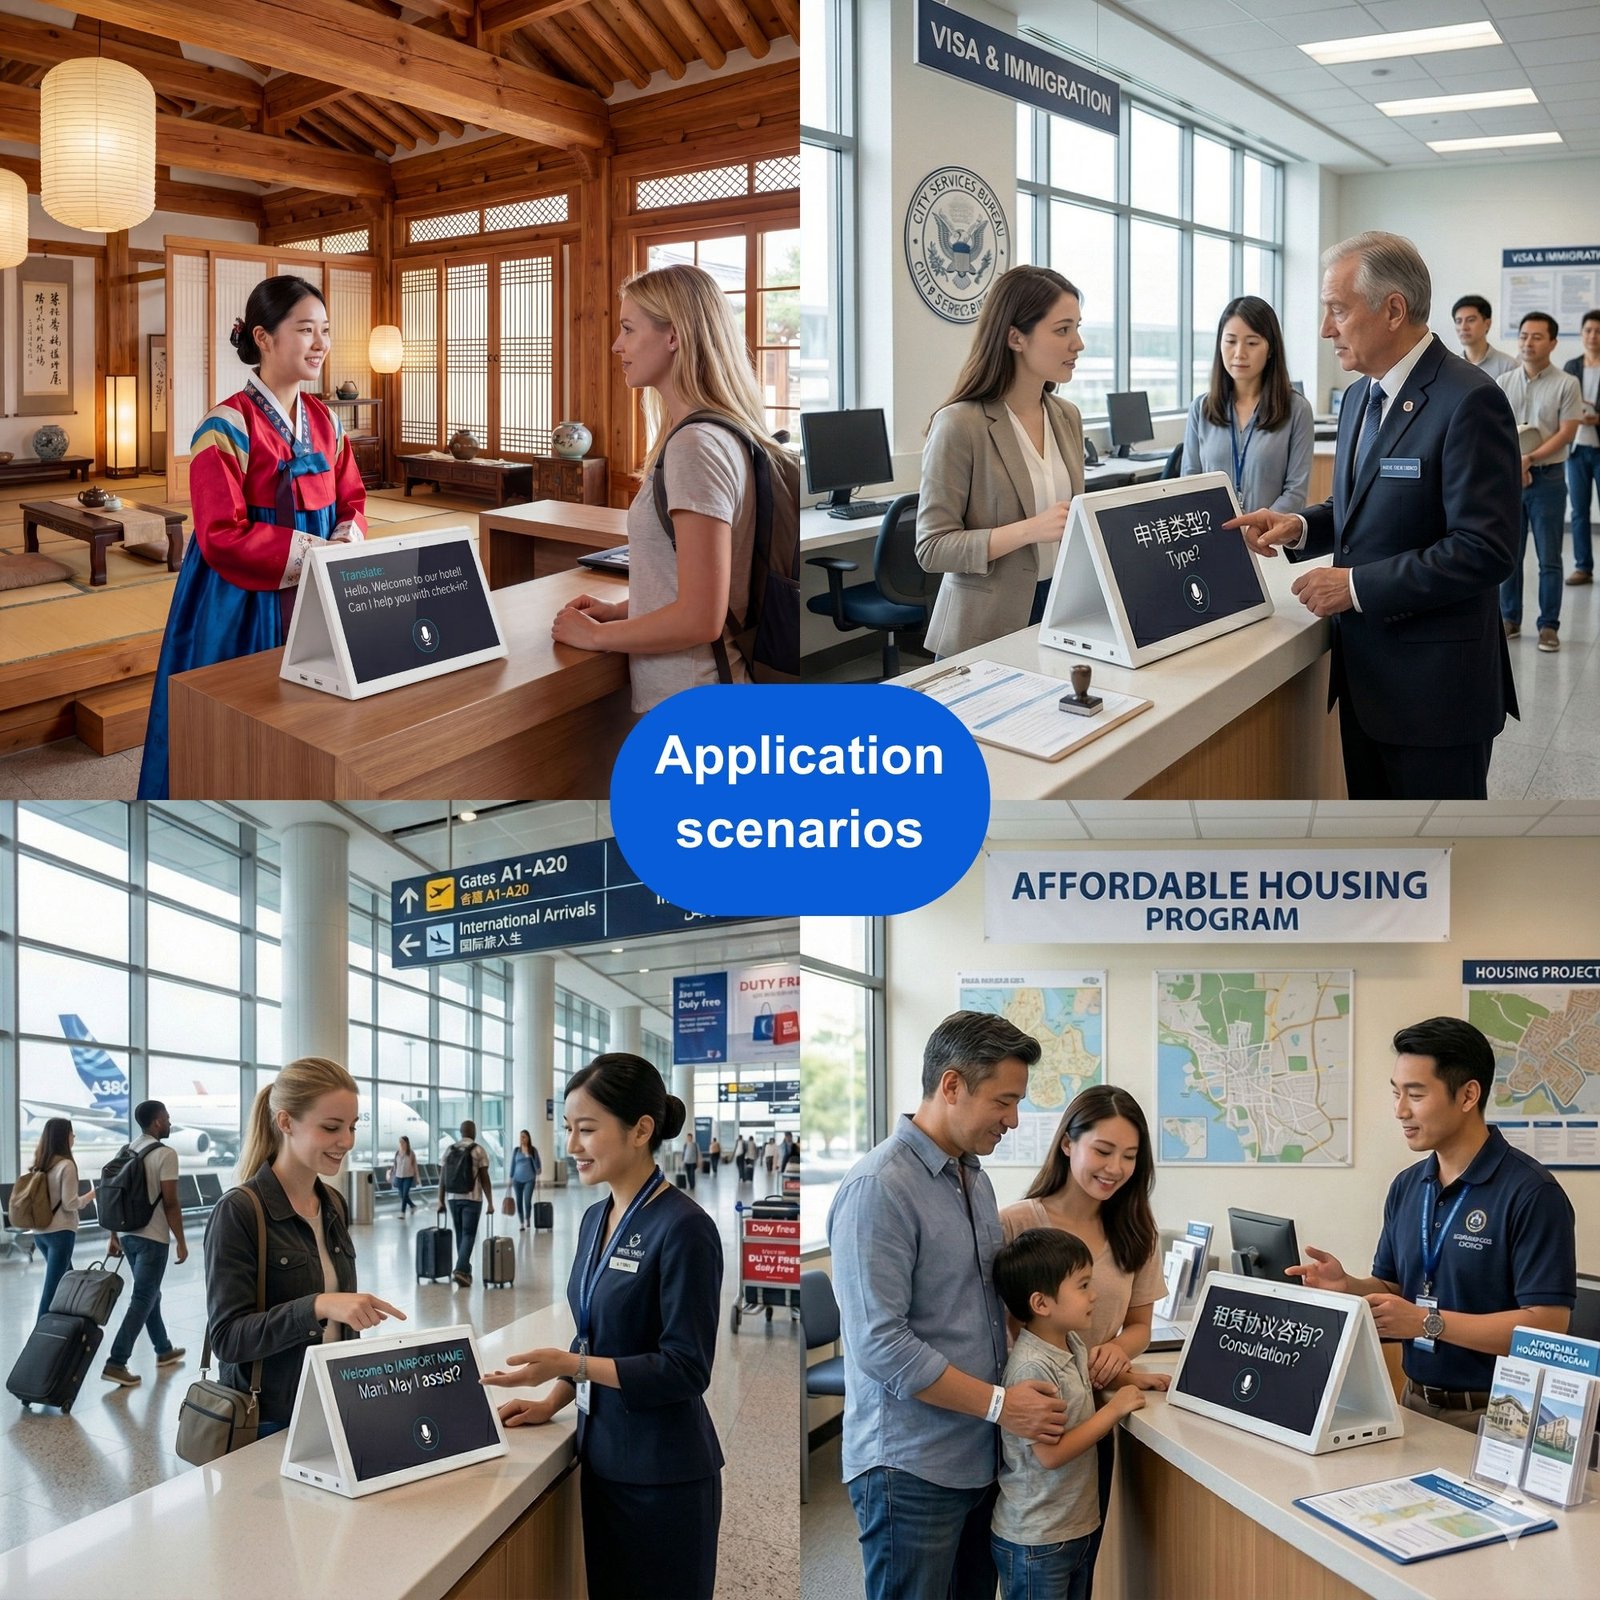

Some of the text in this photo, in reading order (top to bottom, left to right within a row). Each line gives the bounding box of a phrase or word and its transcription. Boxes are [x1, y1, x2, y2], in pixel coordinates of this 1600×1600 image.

[930, 20, 1112, 116] VISA & IMMIGRATION
[913, 174, 1006, 238] CITY SERVICES BUREAU
[1511, 252, 1535, 263] VISA
[1133, 510, 1212, 549] 申请类型?
[1165, 544, 1201, 570] Type?
[340, 566, 385, 582] Translate:
[344, 566, 463, 598] Hello, Welcome to our hotel!
[348, 580, 469, 613] Can I help you with check-in?
[459, 855, 568, 890] Gates A1-A20
[1012, 870, 1428, 900] AFFORDABLE HOUSING
[485, 883, 529, 902] A1-A20
[459, 901, 596, 936] International Arrivals
[1146, 906, 1299, 932] PROGRAM
[740, 978, 775, 992] DUTY
[1475, 966, 1539, 979] HOUSING
[92, 1080, 129, 1096] A380
[748, 1254, 775, 1263] DUTY
[1212, 1305, 1324, 1348] 租赁协议咨询?
[1219, 1334, 1300, 1367] Consultation?
[339, 1365, 382, 1381] Welcome
[389, 1376, 412, 1395] May
[414, 1373, 419, 1388] I
